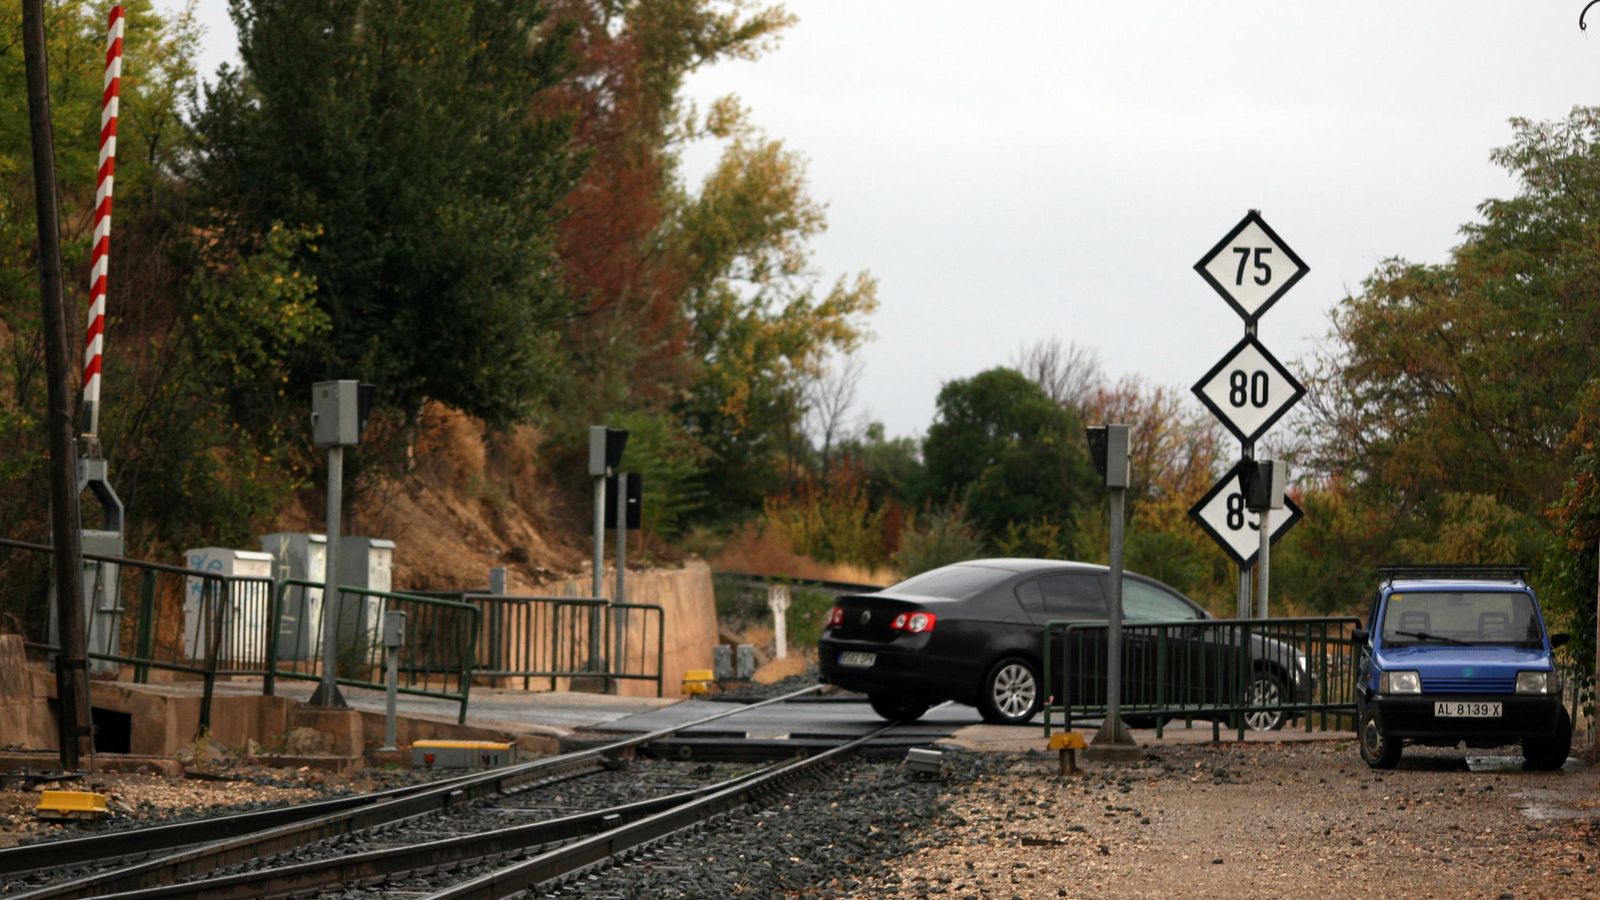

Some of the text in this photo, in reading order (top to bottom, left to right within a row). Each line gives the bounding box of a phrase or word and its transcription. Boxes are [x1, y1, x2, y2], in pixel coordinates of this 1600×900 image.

[1232, 247, 1273, 286] 75
[1229, 369, 1269, 409] 80
[1437, 703, 1500, 716] AL 8139 X
